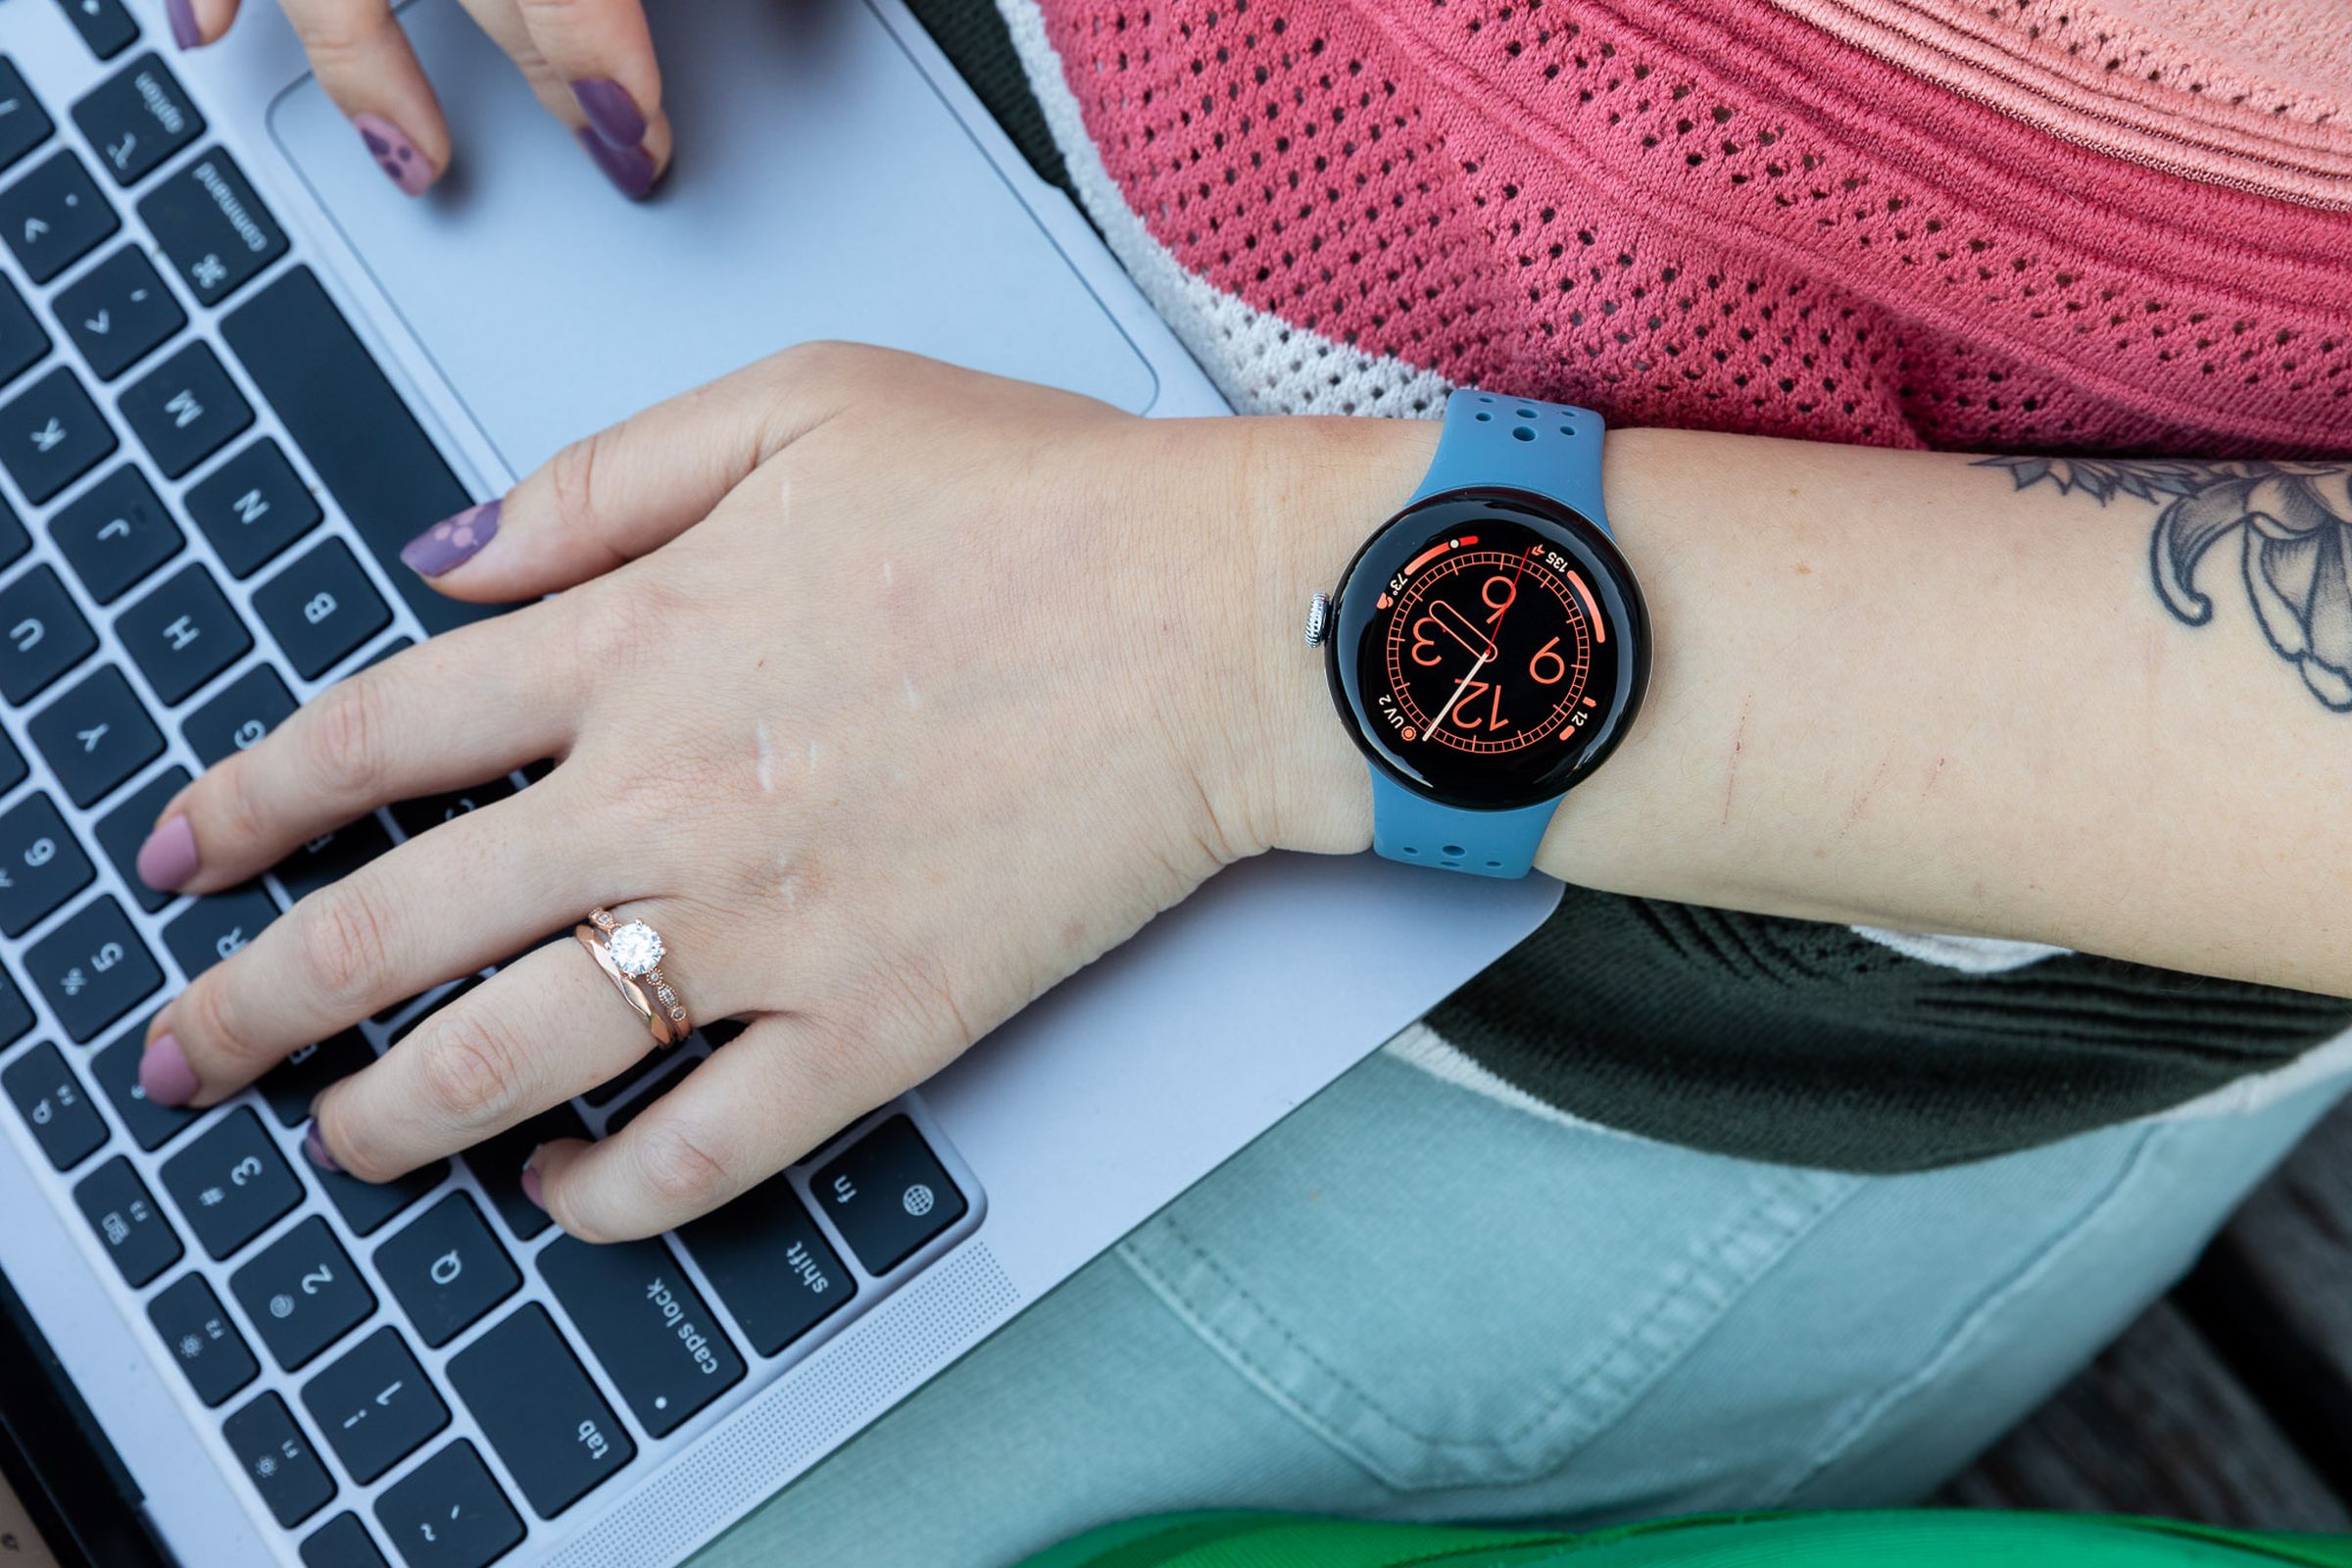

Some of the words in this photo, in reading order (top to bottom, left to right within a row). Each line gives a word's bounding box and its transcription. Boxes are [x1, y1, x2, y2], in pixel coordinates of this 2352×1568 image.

[192, 162, 268, 252] command
[165, 389, 204, 428] M
[30, 416, 67, 452] K
[232, 488, 270, 524] N
[97, 517, 129, 541] J
[1545, 551, 1569, 573] 135
[304, 592, 337, 624] B
[1482, 575, 1517, 624] 6
[9, 617, 45, 652] U
[163, 614, 200, 651] H
[1411, 616, 1443, 666] 3
[1529, 636, 1565, 685] 9
[1378, 694, 1392, 706] 2
[1451, 678, 1510, 732] 12
[1384, 708, 1404, 729] UV
[1571, 710, 1589, 727] 12
[76, 722, 110, 753] Y
[24, 837, 56, 866] 6
[90, 942, 123, 972] 5
[61, 967, 87, 996] %
[231, 1155, 262, 1186] 3
[832, 1174, 858, 1204] fn
[301, 1263, 333, 1295] 2
[430, 1250, 463, 1284] Q
[785, 1241, 829, 1294] shift
[646, 1277, 688, 1329] lock
[677, 1323, 718, 1375] caps
[375, 1380, 403, 1405] 1
[578, 1420, 610, 1460] tab
